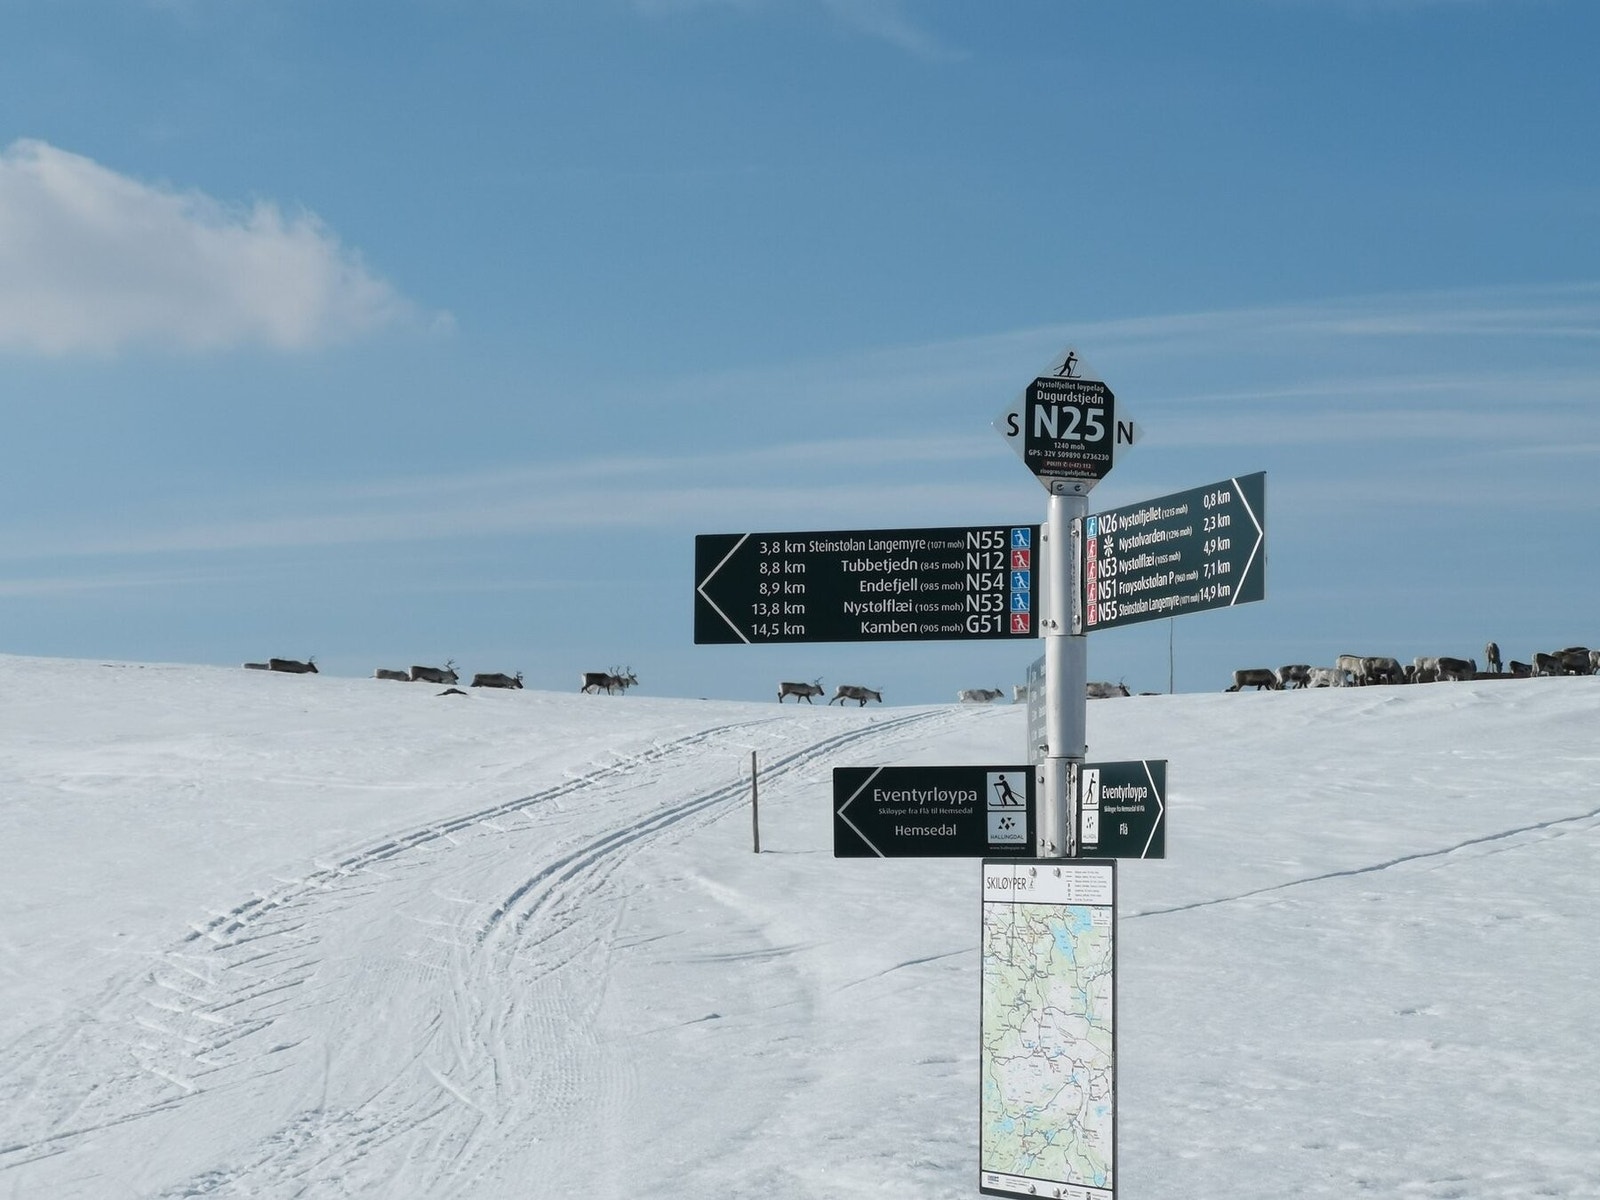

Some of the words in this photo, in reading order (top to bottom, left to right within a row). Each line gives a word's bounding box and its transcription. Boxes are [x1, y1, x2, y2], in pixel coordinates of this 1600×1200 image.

[1037, 390, 1104, 405] Dugurdstjedn
[1006, 412, 1020, 437] S
[1034, 404, 1105, 442] N25
[1117, 420, 1134, 445] N
[1082, 453, 1109, 461] 6736230
[1098, 513, 1118, 535] N26
[1176, 504, 1188, 514] moh)
[1203, 494, 1216, 509] 0,8
[1217, 489, 1230, 504] km
[1180, 526, 1192, 536] moh)
[1203, 517, 1216, 532] 2,3
[1217, 514, 1230, 526] km
[760, 542, 780, 555] 3,8
[784, 540, 806, 553] km
[809, 539, 866, 553] Steinstølan
[868, 537, 926, 554] Langemyre
[927, 540, 946, 550] (1071
[947, 540, 964, 550] moh)
[966, 531, 1004, 549] N55
[760, 562, 780, 576] 8,8
[784, 561, 806, 573] km
[841, 558, 918, 574] Tubbetjedn
[920, 561, 940, 570] (845
[941, 561, 964, 570] moh)
[966, 552, 1004, 570] N12
[1098, 556, 1117, 577] N53
[1169, 551, 1181, 561] moh)
[1203, 541, 1216, 556] 4,9
[1217, 537, 1230, 550] km
[759, 583, 780, 596] 8,9
[784, 581, 806, 593] km
[860, 578, 918, 594] Endefjell
[920, 582, 940, 592] (985
[941, 582, 964, 591] moh)
[966, 573, 1004, 591] N54
[1098, 579, 1116, 600] N51
[1169, 571, 1175, 583] P
[1186, 570, 1198, 580] moh)
[1203, 564, 1216, 580] 7,1
[1217, 560, 1230, 573] km
[752, 603, 780, 617] 13,8
[784, 602, 806, 614] km
[844, 599, 912, 616] Nystølflæi
[915, 603, 940, 612] (1055
[941, 603, 964, 612] moh)
[966, 594, 1004, 612] N53
[1098, 601, 1118, 621] N55
[1149, 594, 1180, 611] Langemyre
[1199, 586, 1216, 602] 14,9
[1217, 584, 1230, 596] km
[752, 624, 780, 637] 14,5
[784, 622, 805, 634] km
[861, 620, 917, 634] Kamben
[920, 624, 940, 634] (905
[941, 624, 964, 633] moh)
[966, 615, 1002, 633] G51
[874, 787, 978, 805] Eventyrløypa
[1102, 783, 1148, 803] Eventyrløypa
[895, 824, 957, 836] Hemsedal
[1119, 822, 1128, 835] Flå
[986, 876, 1027, 890] SKILØYPER
